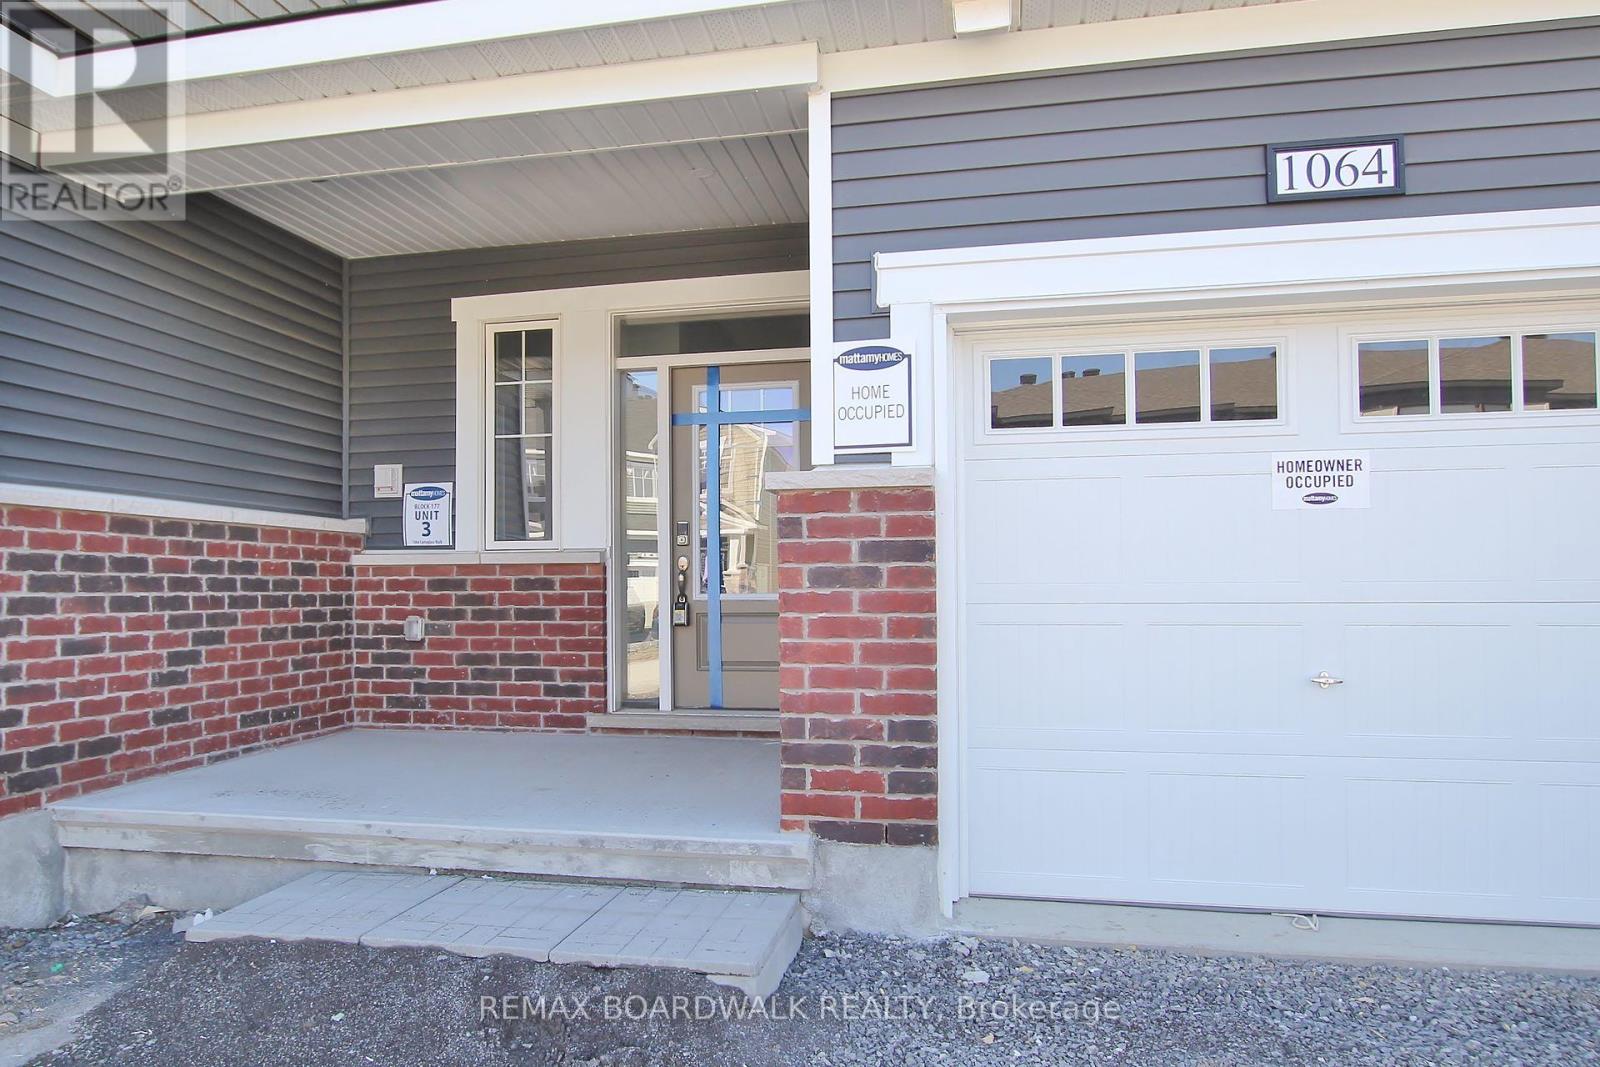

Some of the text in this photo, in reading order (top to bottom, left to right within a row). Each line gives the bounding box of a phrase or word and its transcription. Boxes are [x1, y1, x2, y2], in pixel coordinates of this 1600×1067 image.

[1283, 148, 1388, 191] 1064
[851, 384, 891, 400] HOME
[838, 403, 905, 421] OCCUPIED
[1277, 459, 1362, 473] HOMEOWNER
[1286, 474, 1354, 489] OCCUPIED
[415, 510, 439, 520] UNIT
[421, 521, 431, 536] 3
